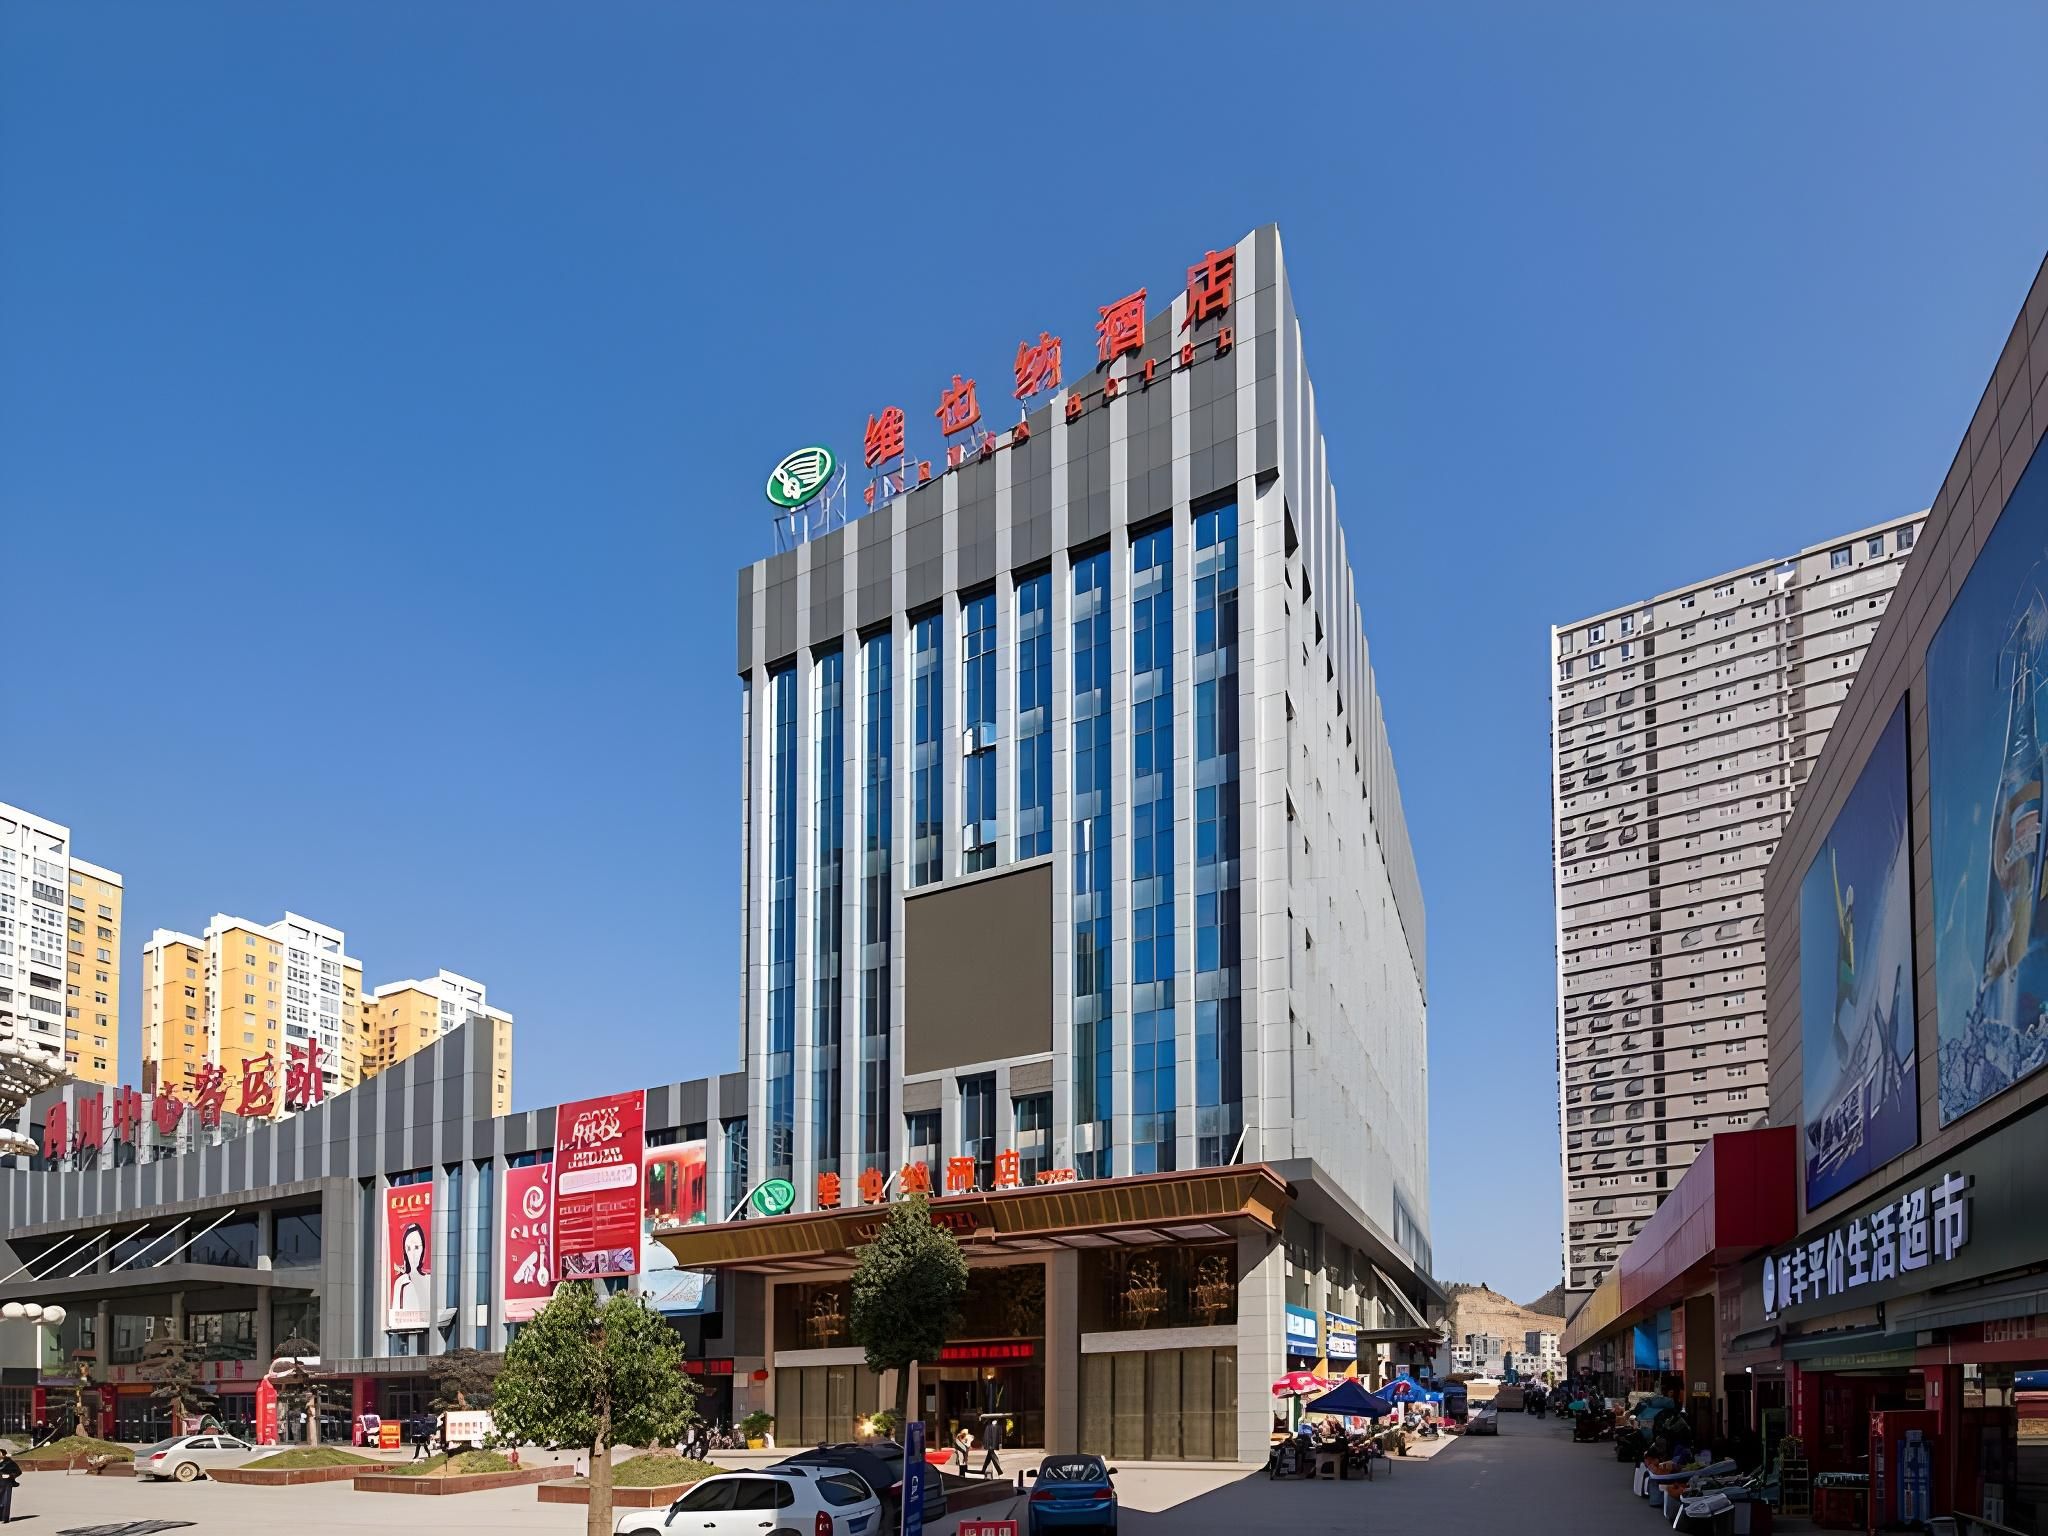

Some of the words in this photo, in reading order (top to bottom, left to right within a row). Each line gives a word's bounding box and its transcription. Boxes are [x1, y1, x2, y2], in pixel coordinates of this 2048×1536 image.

[864, 249, 1236, 470] 维也纳酒店
